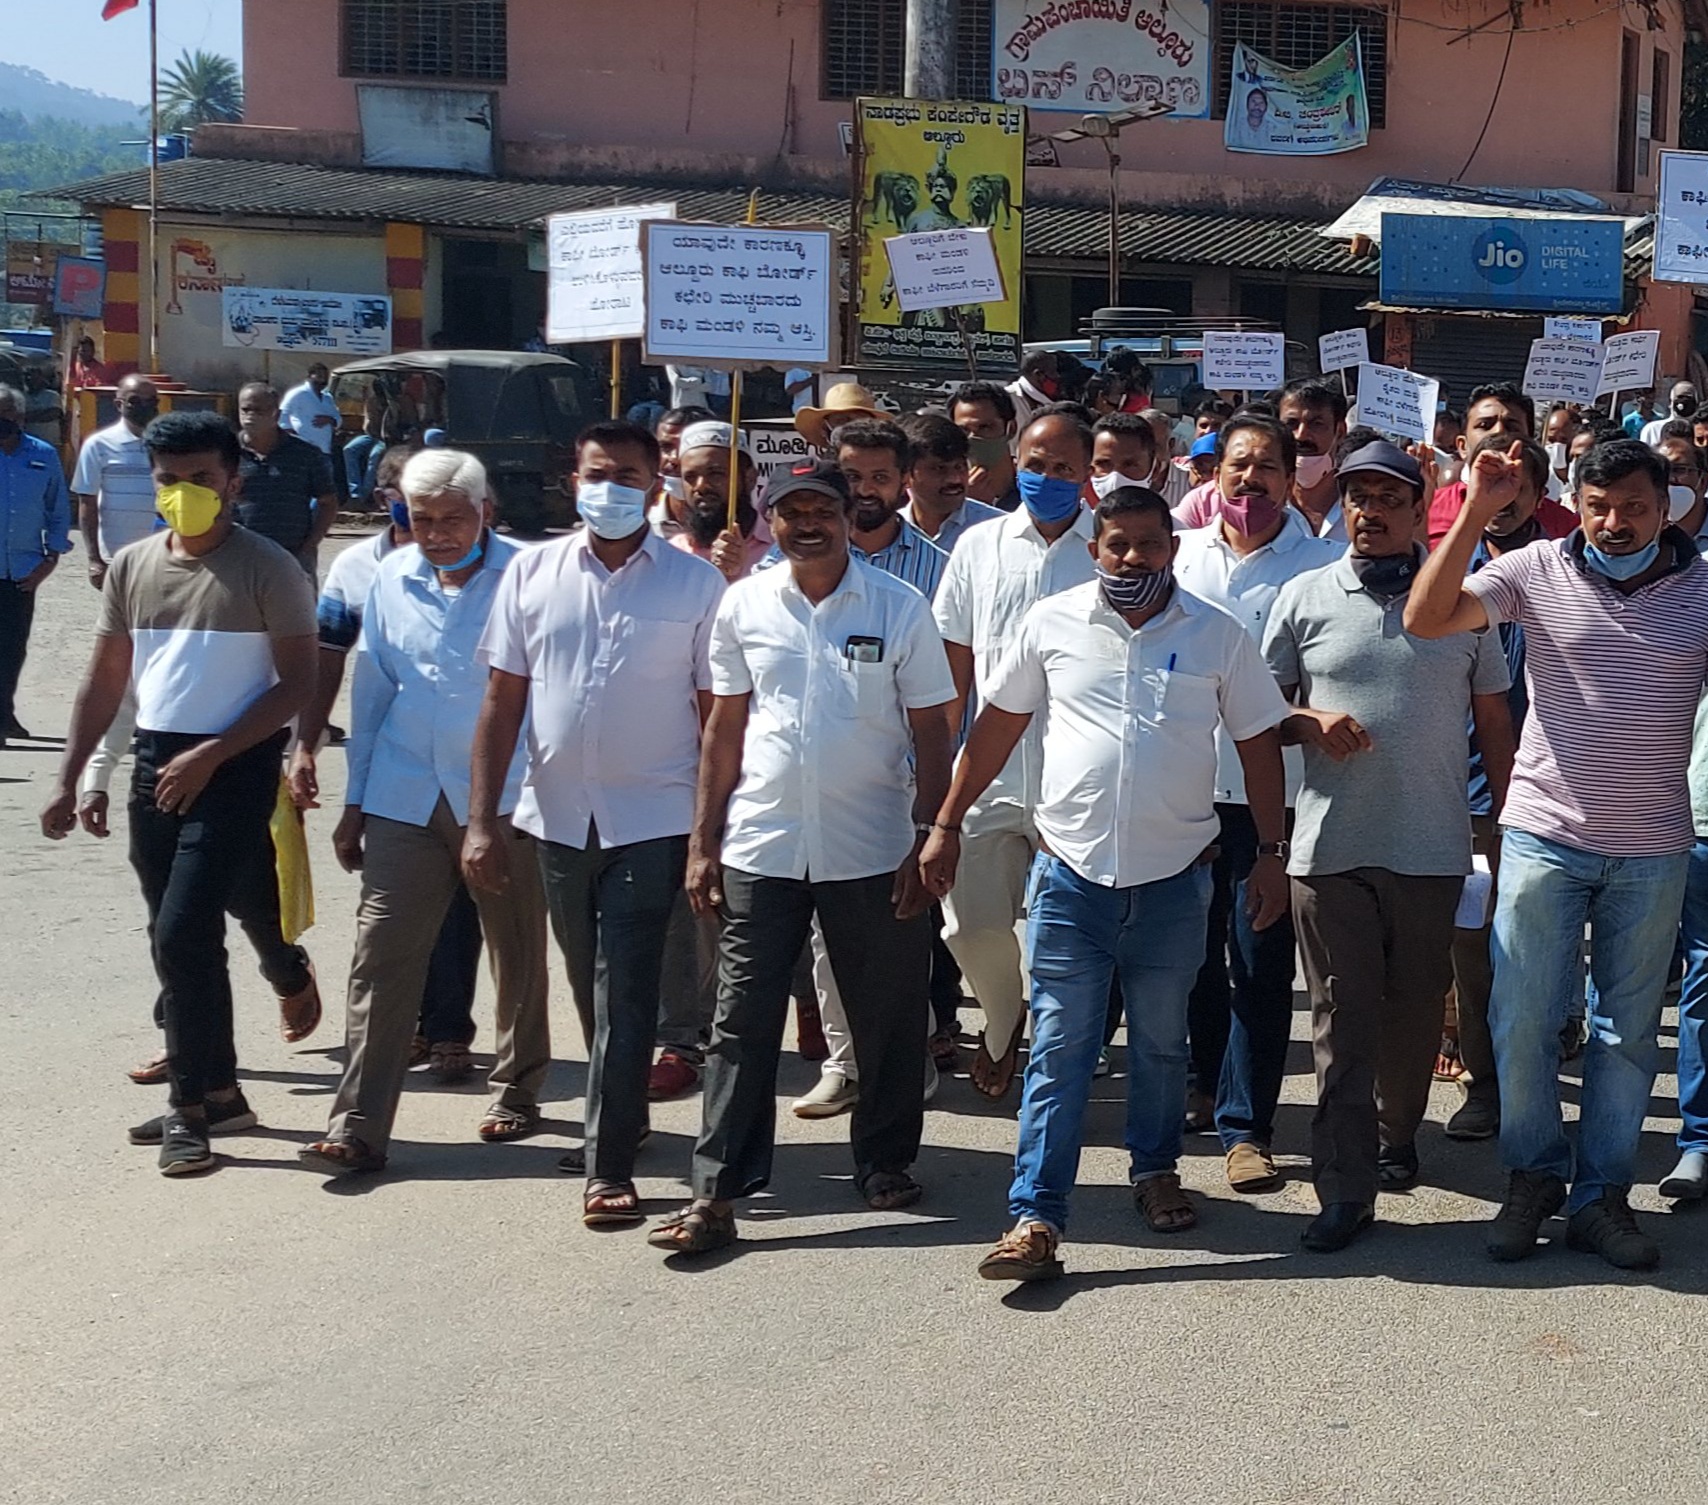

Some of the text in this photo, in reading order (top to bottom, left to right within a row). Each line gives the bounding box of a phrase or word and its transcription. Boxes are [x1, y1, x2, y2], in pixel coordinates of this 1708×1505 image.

[1135, 9, 1194, 67] ಆಲ್ದೂರು
[998, 61, 1077, 99] ಬಸ್
[866, 104, 920, 126] ನಾಡಪ್ರಭು
[997, 108, 1020, 134] ವೃತ್ತ
[673, 236, 735, 251] ಯಾವುದೇ
[1478, 240, 1525, 268] Jio
[1541, 246, 1590, 259] DIGITAL
[660, 263, 713, 282] ಆಲ್ದೂರು
[757, 264, 817, 280] ಬೋರ್ಡ್
[1541, 259, 1568, 270] LIFE
[696, 319, 745, 332] ಮಂಡಳಿ
[753, 322, 784, 342] ನಮ್ಮ
